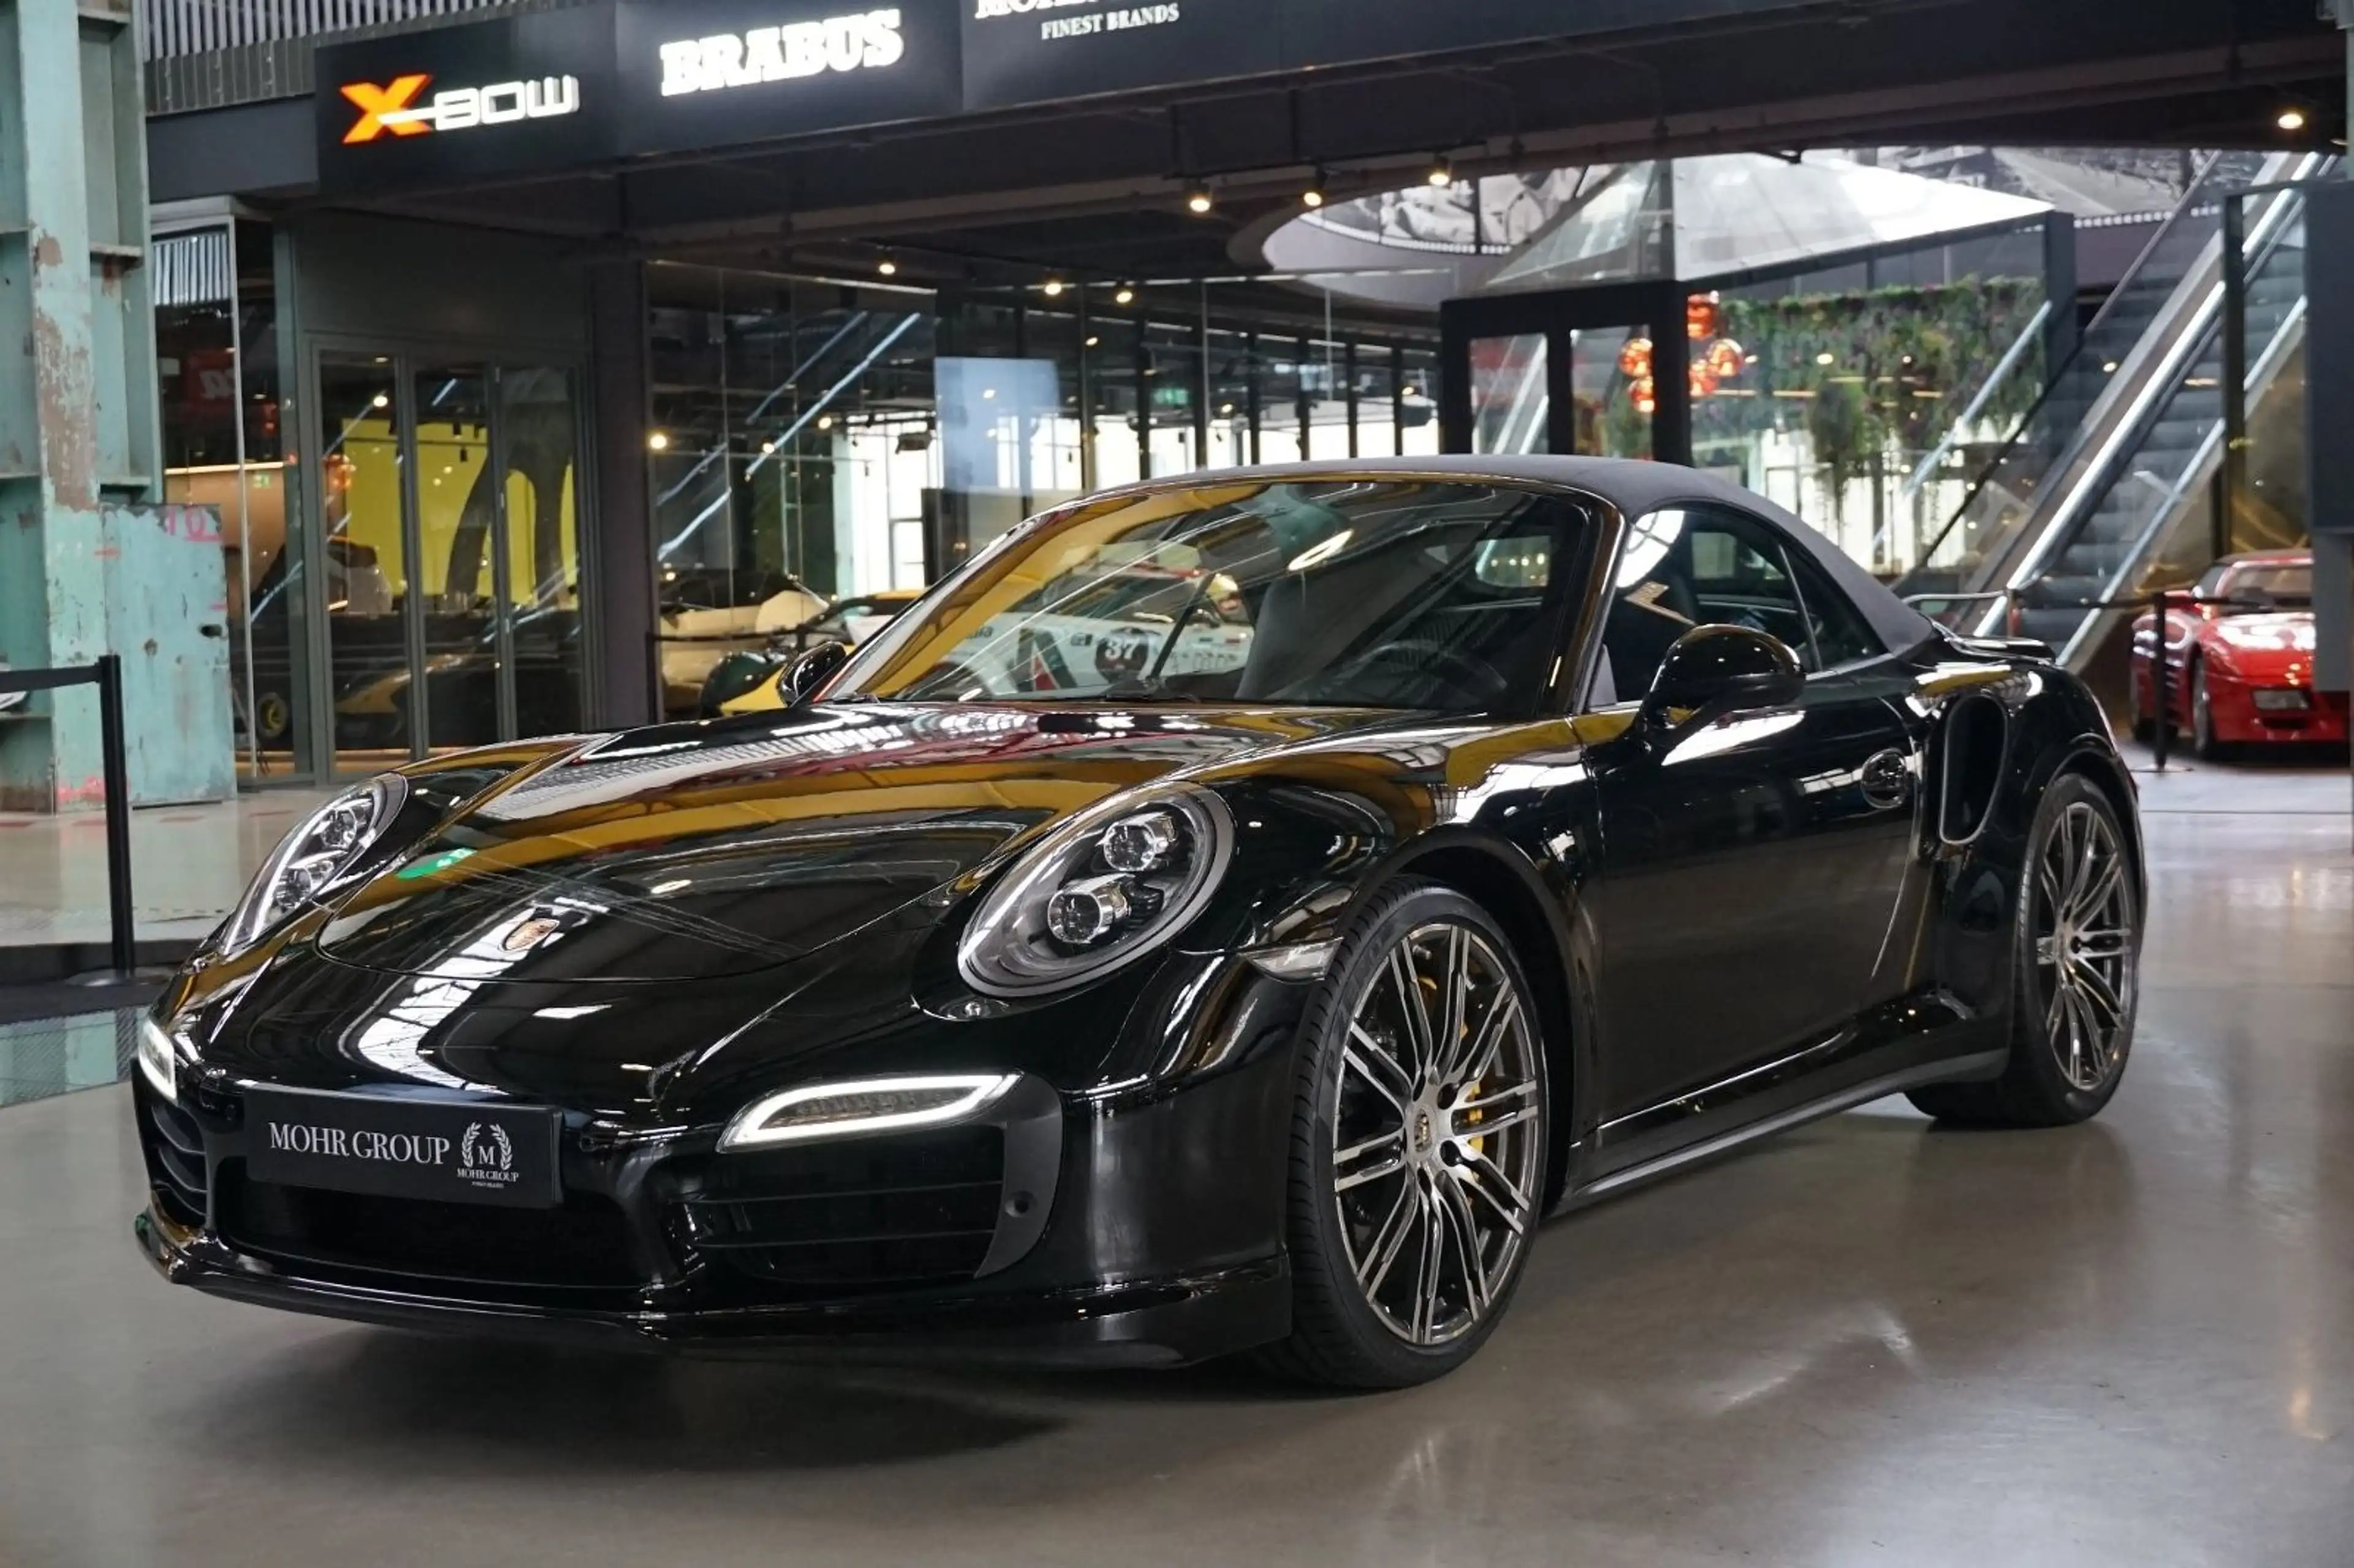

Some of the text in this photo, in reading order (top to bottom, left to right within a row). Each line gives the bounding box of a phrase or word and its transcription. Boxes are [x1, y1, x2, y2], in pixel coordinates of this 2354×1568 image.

[1042, 13, 1103, 40] FINEST
[1106, 2, 1180, 31] BRANDS
[660, 9, 904, 96] BRABUS
[1105, 635, 1140, 660] 37
[269, 1122, 450, 1165] MOHR GROUP
[478, 1145, 495, 1165] M
